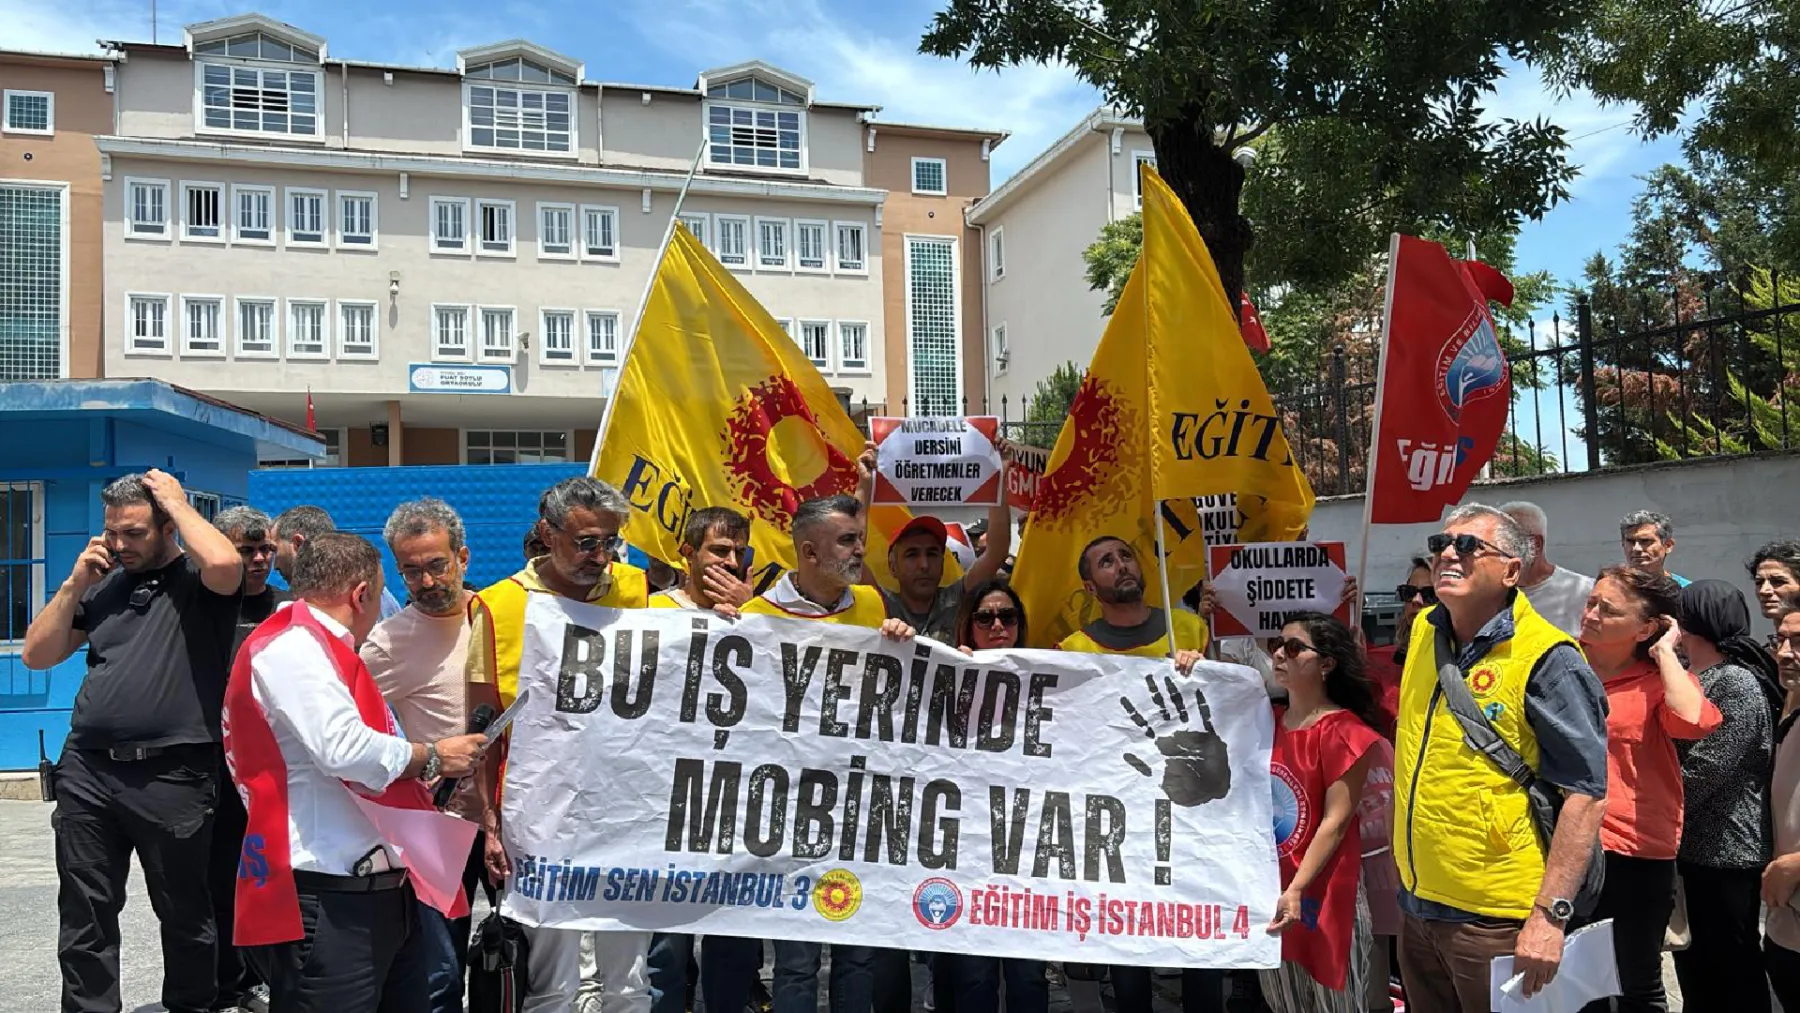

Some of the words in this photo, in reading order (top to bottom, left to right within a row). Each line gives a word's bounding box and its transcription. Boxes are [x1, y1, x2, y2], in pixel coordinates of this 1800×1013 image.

[915, 437, 962, 455] DERSİNİ
[1172, 397, 1293, 467] EĞİT
[895, 460, 980, 479] ÖĞRETMENLER
[911, 487, 962, 502] VERECEK
[1198, 510, 1237, 530] KUL
[1231, 546, 1330, 569] OKULLARDA
[1247, 576, 1315, 607] ŞİDDETE
[555, 622, 660, 720] BU
[679, 618, 753, 750] İŞ
[781, 642, 1059, 759] YERİNDE
[665, 755, 962, 870] MOBİNG
[989, 786, 1126, 883] VAR
[514, 854, 601, 901] EĞİTİM
[603, 868, 659, 902] SEN
[663, 863, 784, 909] İSTANBUL
[791, 875, 810, 910] 3
[969, 884, 1059, 930] EĞİTİM
[1066, 890, 1091, 942] İŞ
[1098, 893, 1227, 940] İSTANBUL
[1232, 905, 1251, 940] 4
